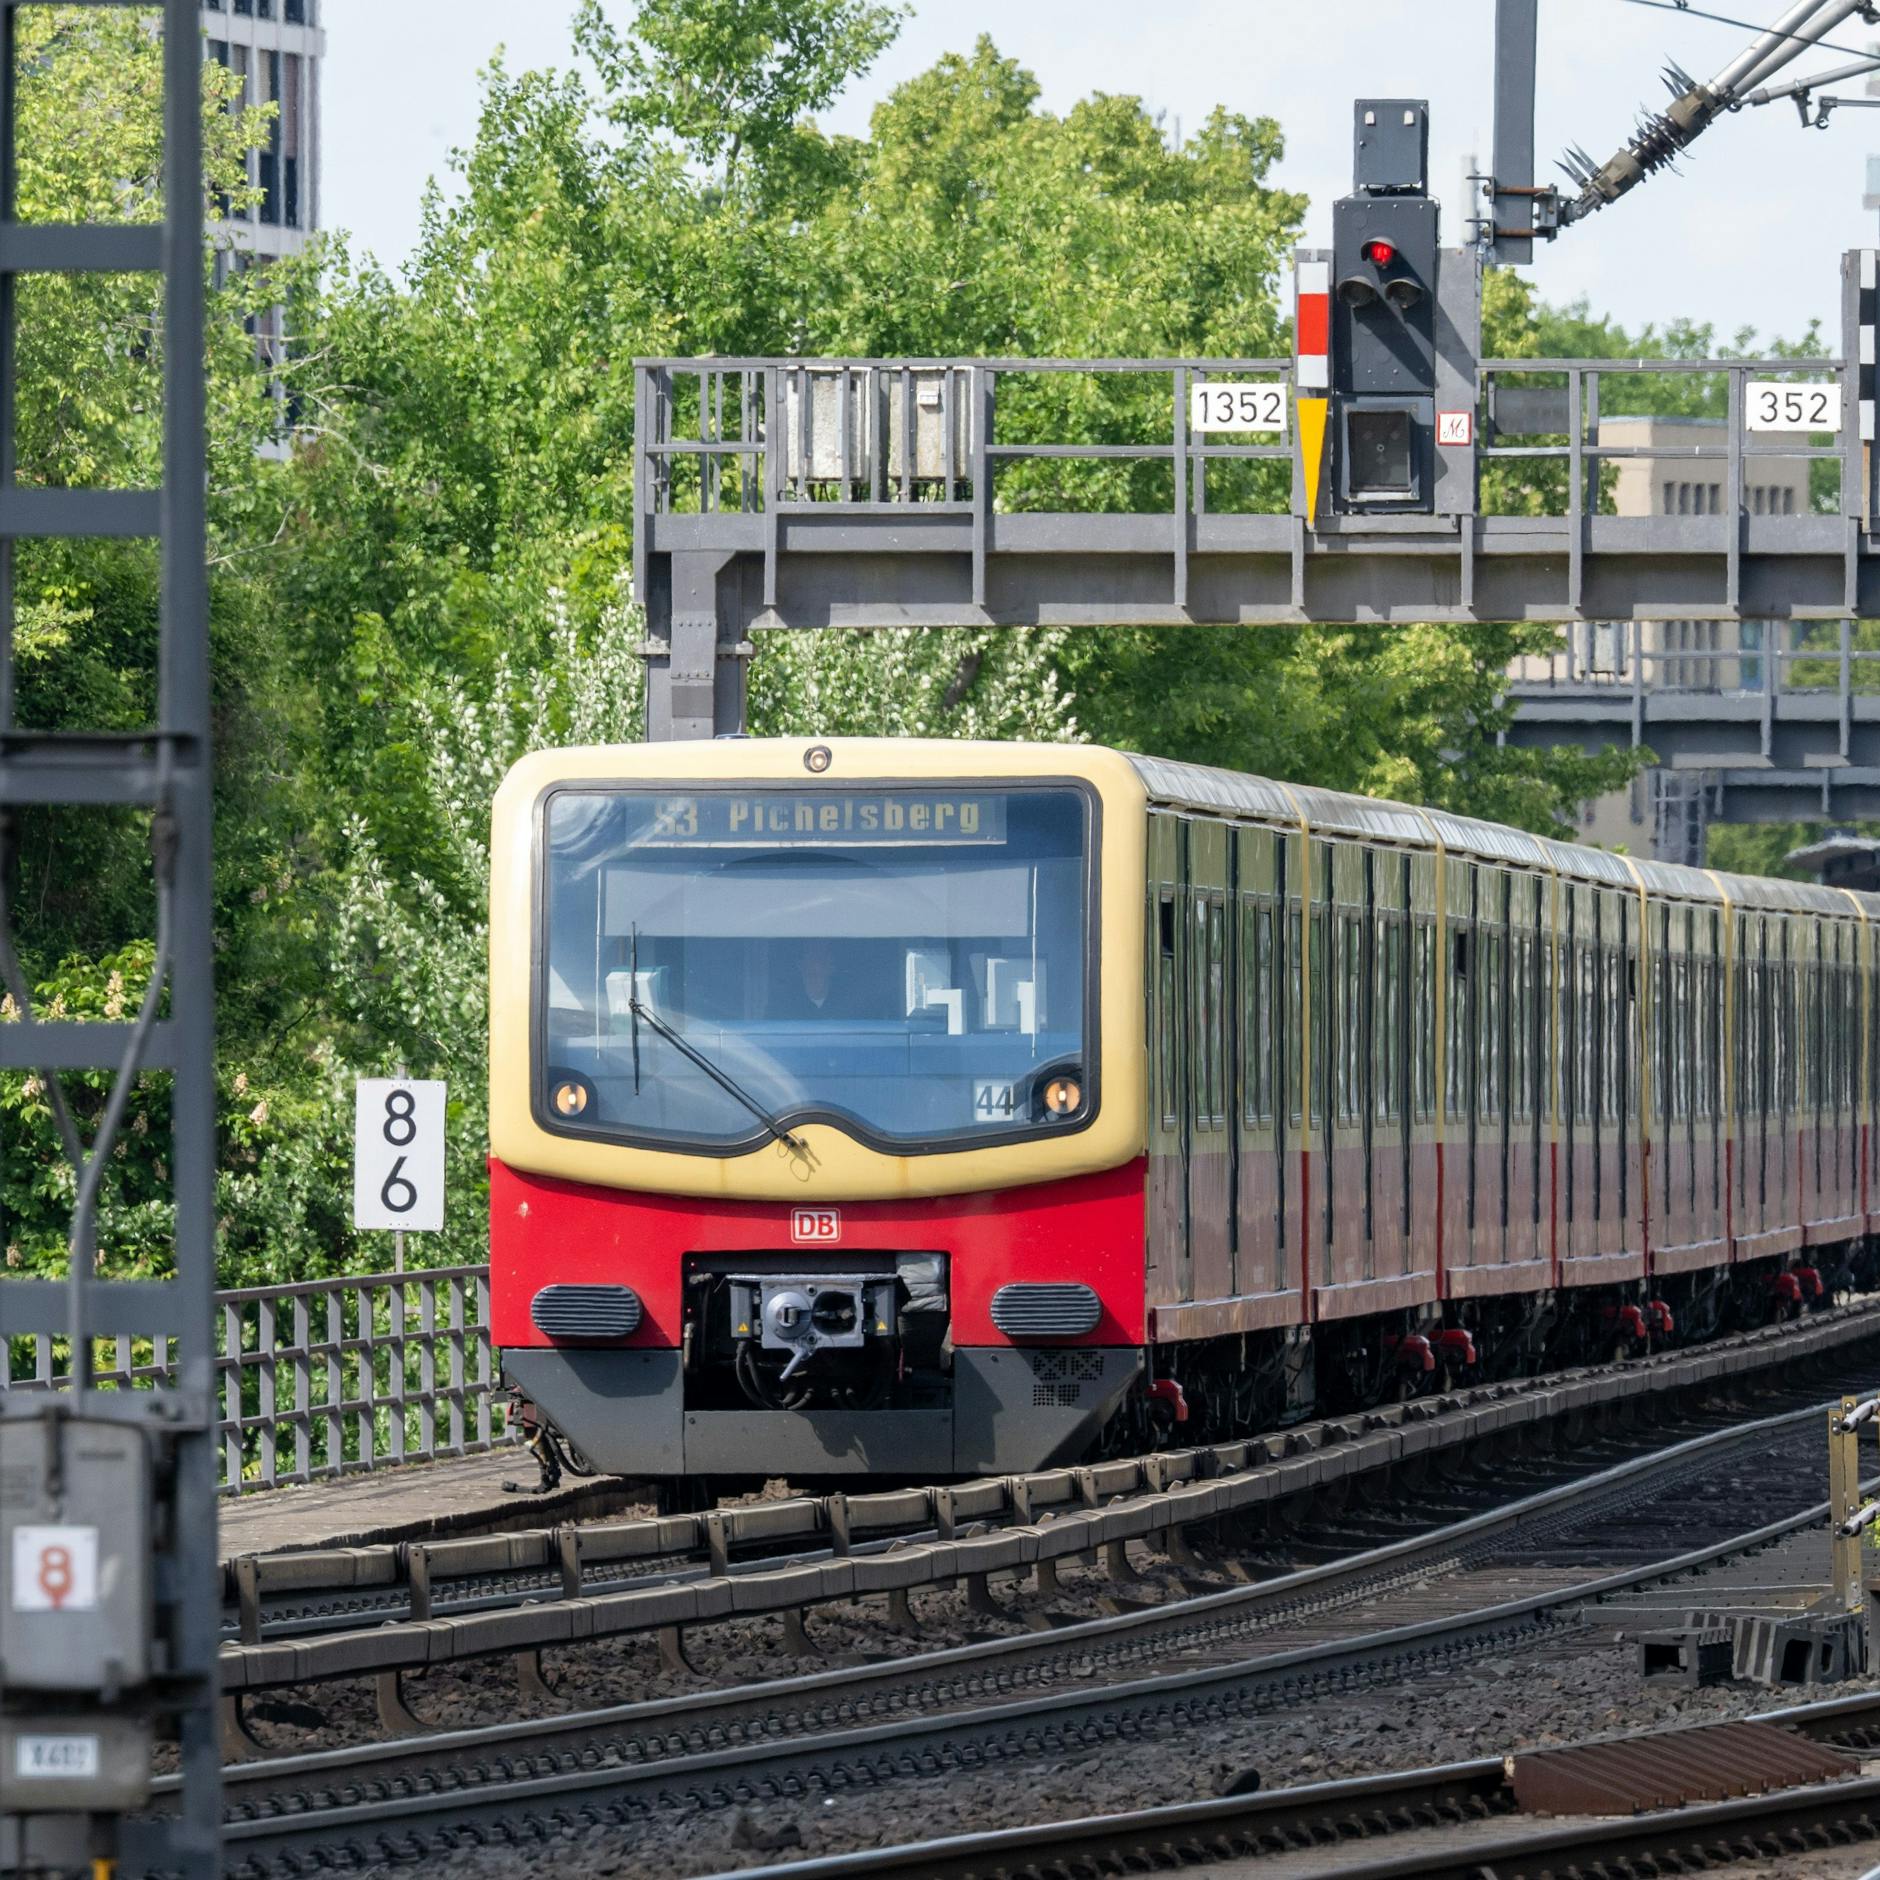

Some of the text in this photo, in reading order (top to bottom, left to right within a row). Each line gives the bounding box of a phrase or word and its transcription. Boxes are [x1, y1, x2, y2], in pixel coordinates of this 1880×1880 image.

[1199, 391, 1281, 423] 1352
[1760, 391, 1828, 423] 352
[729, 798, 980, 834] Pichelsberg
[976, 1085, 1014, 1116] 44
[383, 1089, 417, 1147] 8
[381, 1155, 418, 1213] 6
[798, 1214, 834, 1236] DB
